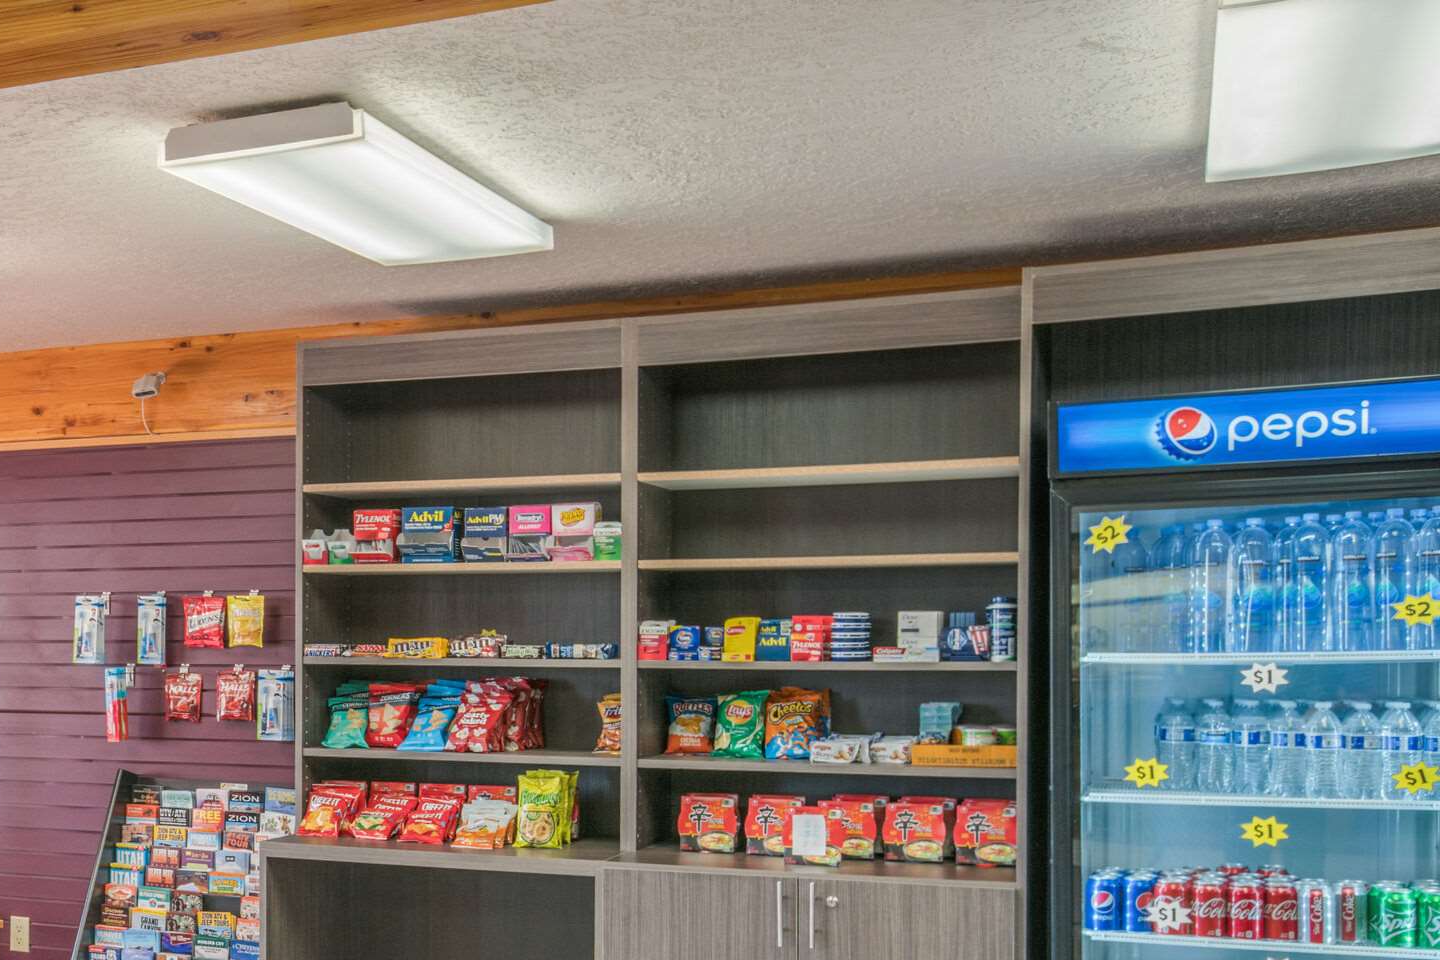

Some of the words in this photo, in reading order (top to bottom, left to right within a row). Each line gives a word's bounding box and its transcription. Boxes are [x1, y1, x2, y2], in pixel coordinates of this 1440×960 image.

[1228, 400, 1370, 451] pepsi
[409, 510, 444, 523] Advil
[1096, 525, 1121, 544] $2
[1405, 602, 1432, 618] $2
[760, 637, 786, 647] Advil
[1253, 669, 1274, 685] $1
[768, 702, 813, 721] Cheetos
[1136, 766, 1156, 780] $1
[1405, 769, 1428, 785] $1
[231, 794, 259, 802] ZION
[193, 810, 221, 822] FREE
[228, 815, 257, 823] ZION
[1253, 823, 1274, 839] $1
[111, 868, 138, 886] UTAH
[141, 916, 159, 925] GRAND
[1158, 906, 1177, 922] $1
